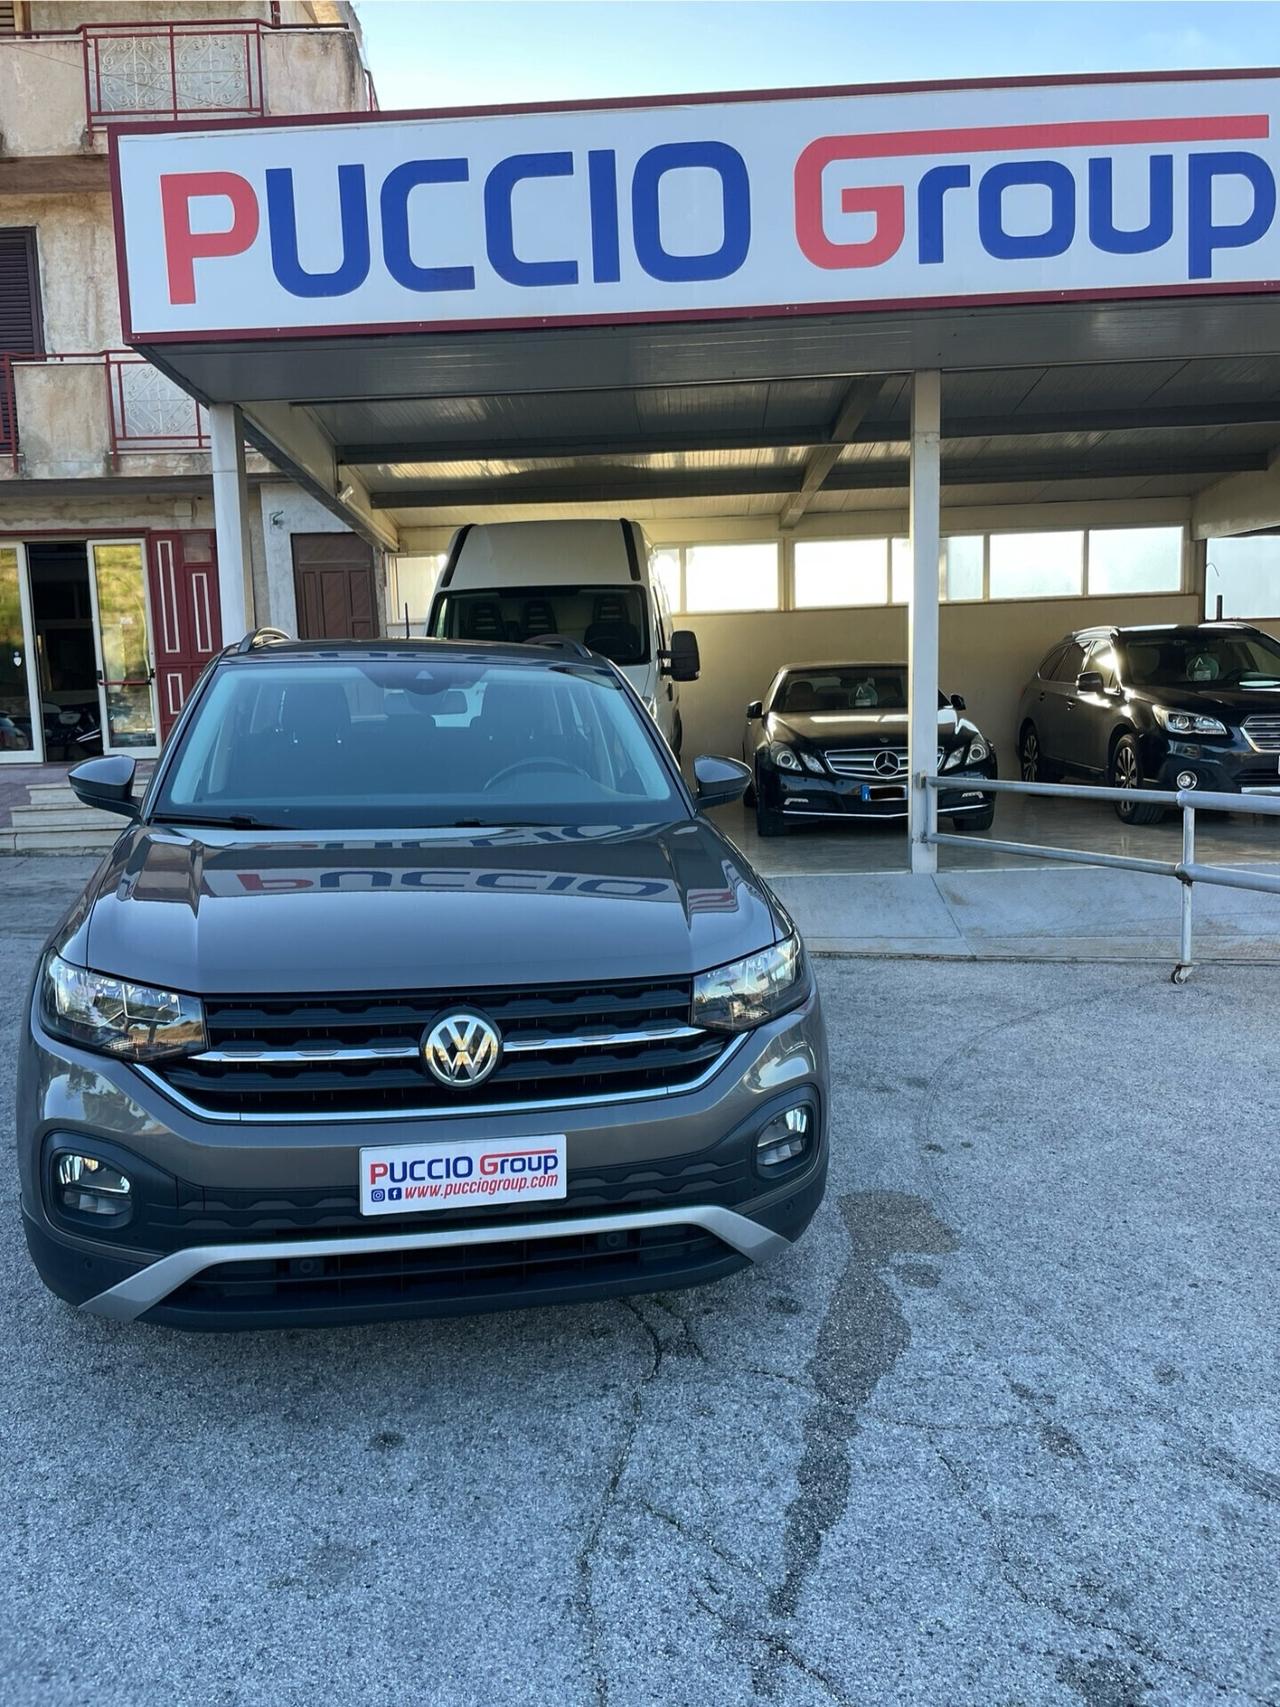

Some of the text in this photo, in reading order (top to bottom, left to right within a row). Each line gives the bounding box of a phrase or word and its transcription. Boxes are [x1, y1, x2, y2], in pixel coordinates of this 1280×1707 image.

[161, 115, 1276, 305] PUCCIO Group
[426, 1014, 499, 1087] VW
[370, 1149, 558, 1185] PUCCIO Group
[405, 1174, 557, 1199] www.pucciogroup.com
